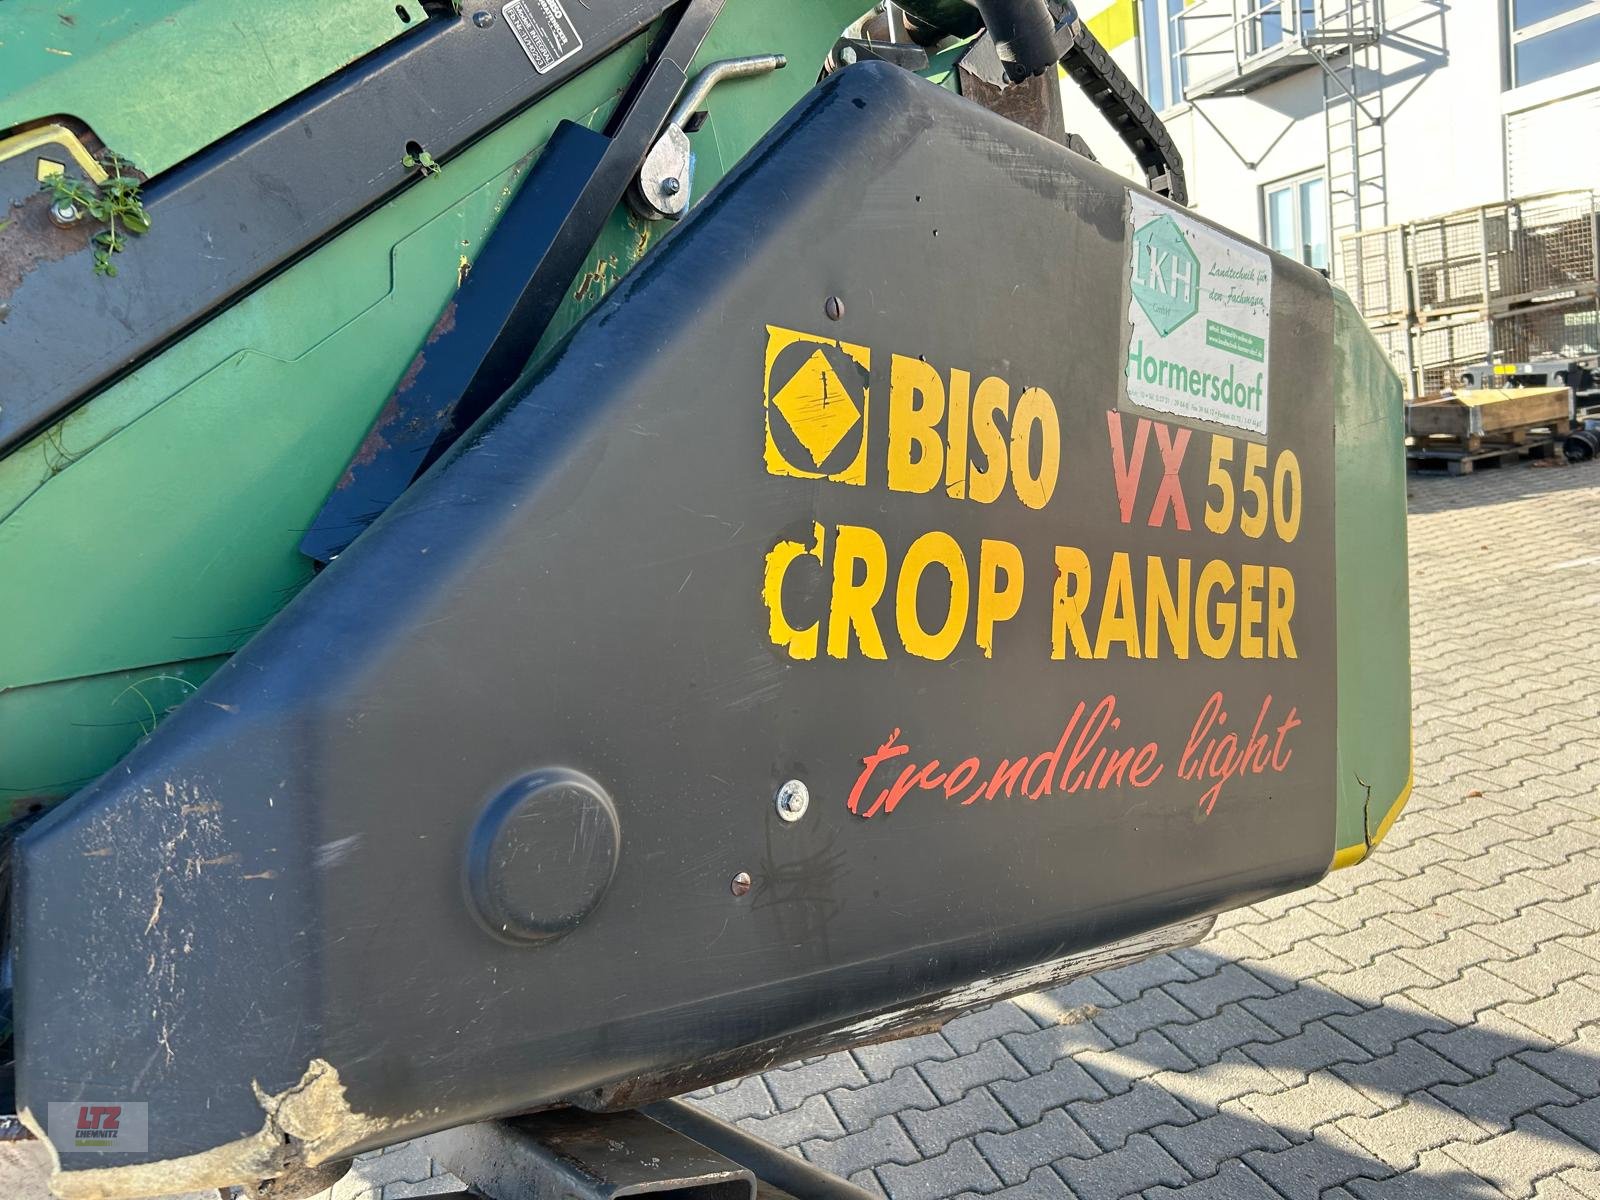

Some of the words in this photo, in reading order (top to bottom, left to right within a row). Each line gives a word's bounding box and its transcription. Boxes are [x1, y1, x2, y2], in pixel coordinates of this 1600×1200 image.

[529, 30, 552, 64] INTEGRAL
[1131, 240, 1193, 304] LKH
[1208, 261, 1255, 281] Landtechnik
[1126, 338, 1263, 412] Hormersdorf
[887, 353, 1061, 510] BISO
[1107, 409, 1192, 531] VX
[1203, 434, 1302, 543] 550
[762, 520, 1025, 662] CROP
[1050, 545, 1298, 661] RANGER
[846, 694, 1164, 819] trendline
[1176, 691, 1302, 816] light
